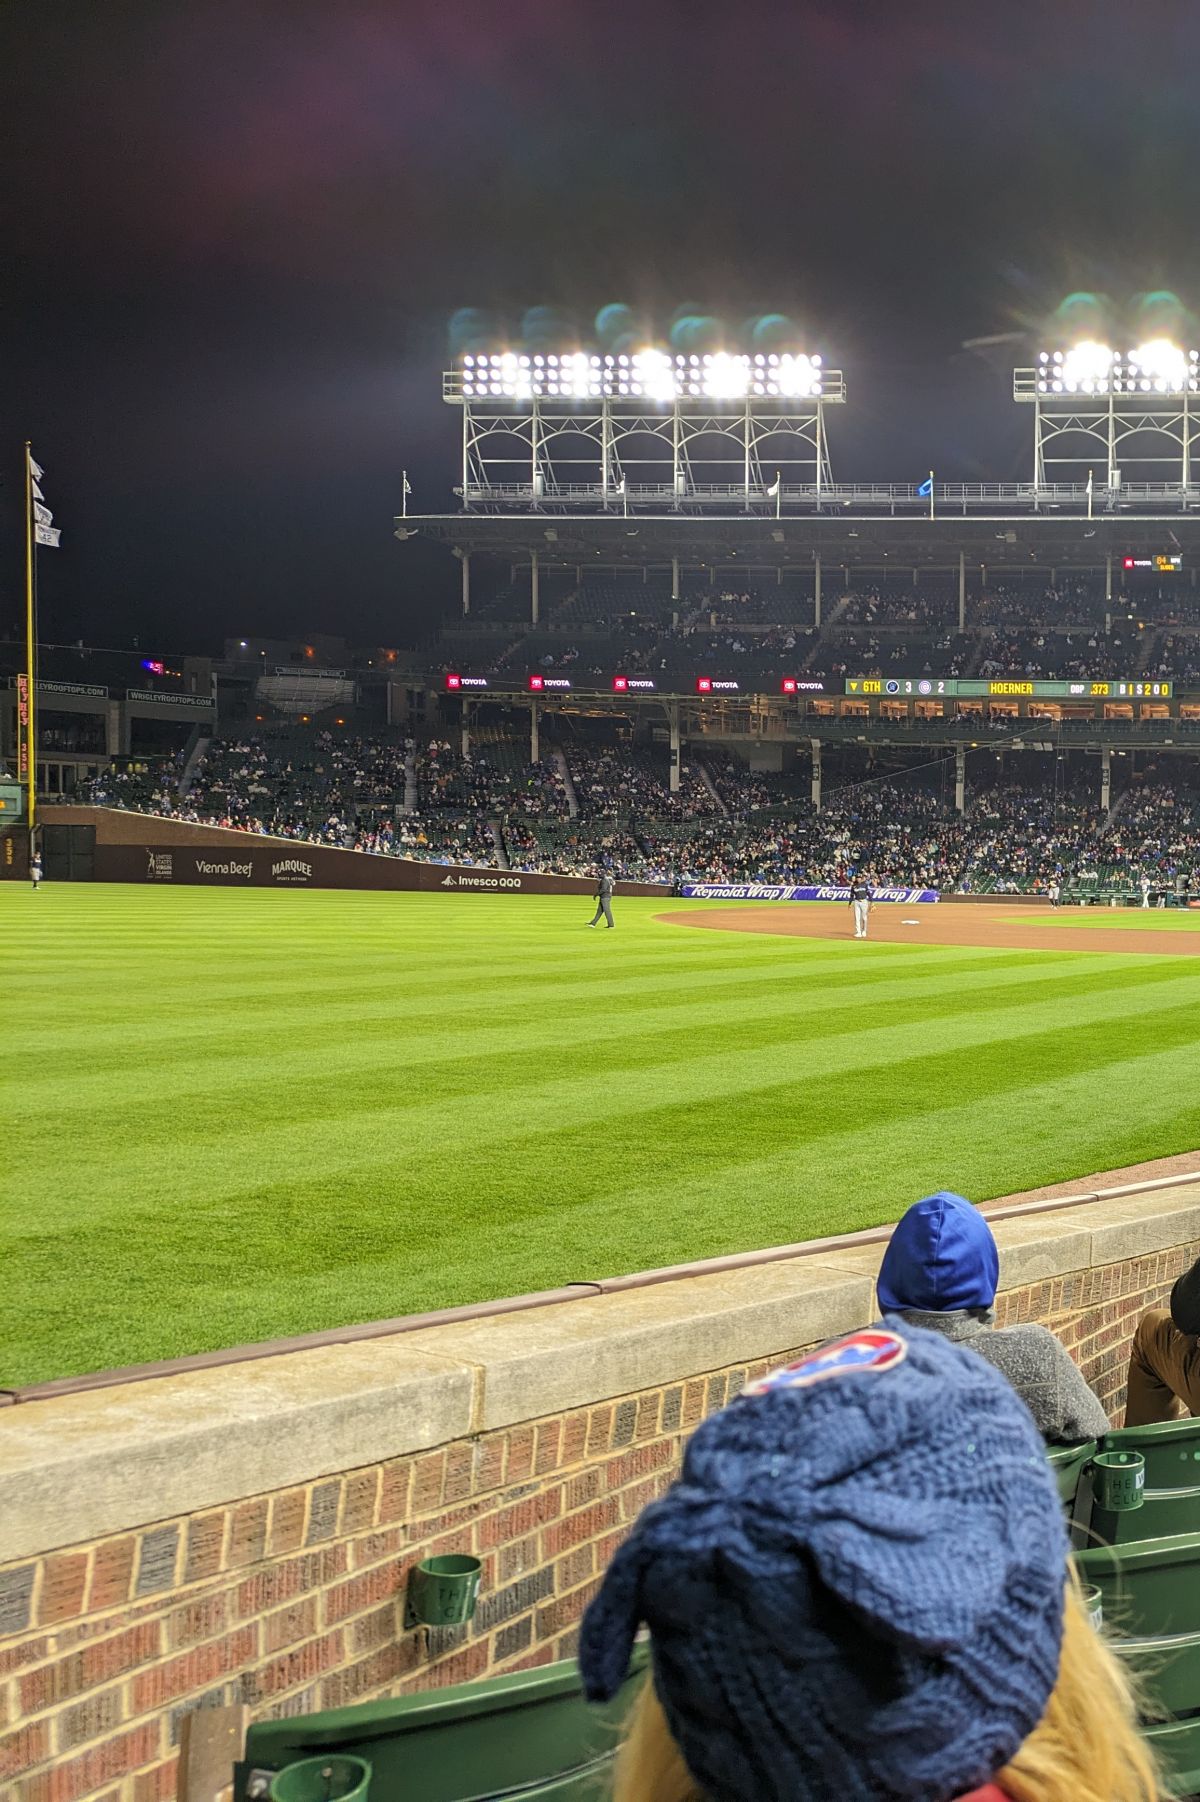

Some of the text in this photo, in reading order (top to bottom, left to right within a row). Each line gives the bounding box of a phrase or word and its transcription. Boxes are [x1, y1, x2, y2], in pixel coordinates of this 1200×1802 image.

[627, 680, 654, 688] TOYOTA
[711, 681, 738, 689] TOYOTA
[796, 682, 823, 690] TOYOTA
[863, 681, 944, 693] 6TH 3 2
[990, 683, 1033, 695] HOERNER
[1119, 684, 1126, 694] B
[1136, 684, 1143, 695] S
[1144, 684, 1151, 695] 2
[195, 860, 253, 878] Vienna Beef
[271, 859, 313, 877] MARQUEE
[458, 876, 521, 888] Invesco QQQ
[691, 886, 780, 900] Reynolds Wrap
[871, 888, 907, 901] Wrap
